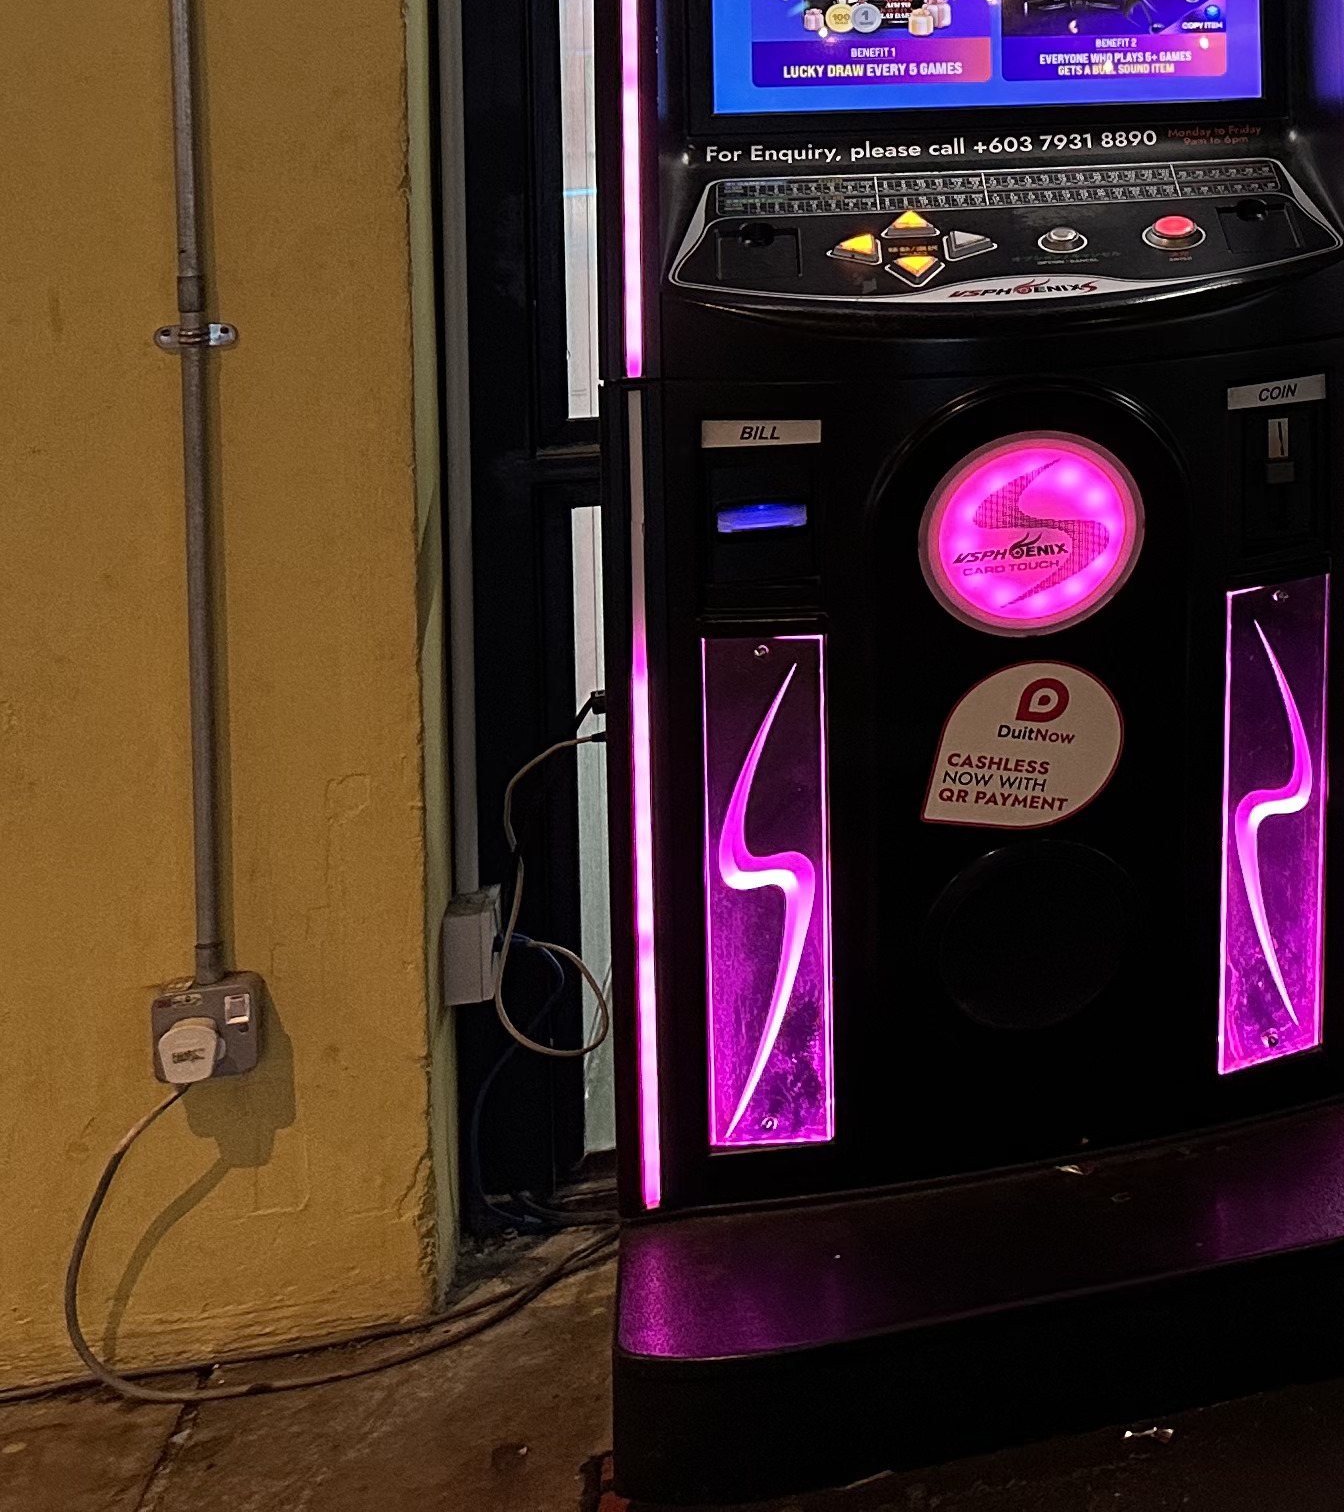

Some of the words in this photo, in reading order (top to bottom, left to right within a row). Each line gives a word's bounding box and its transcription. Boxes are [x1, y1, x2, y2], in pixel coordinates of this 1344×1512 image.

[707, 145, 742, 163] For
[750, 143, 843, 164] Enquiry,
[851, 141, 923, 162] please
[929, 137, 966, 156] call
[974, 134, 1034, 154] +603
[1040, 132, 1094, 151] 7931
[1101, 130, 1157, 149] 8890
[1258, 383, 1298, 402] COIN
[741, 425, 781, 441] BILL
[997, 724, 1076, 744] DuitNow
[947, 753, 1050, 775] CASHLESS
[943, 770, 994, 787] NOW
[1000, 775, 1047, 792] WITH
[939, 788, 968, 804] QR
[974, 791, 1069, 812] PAYMENT
